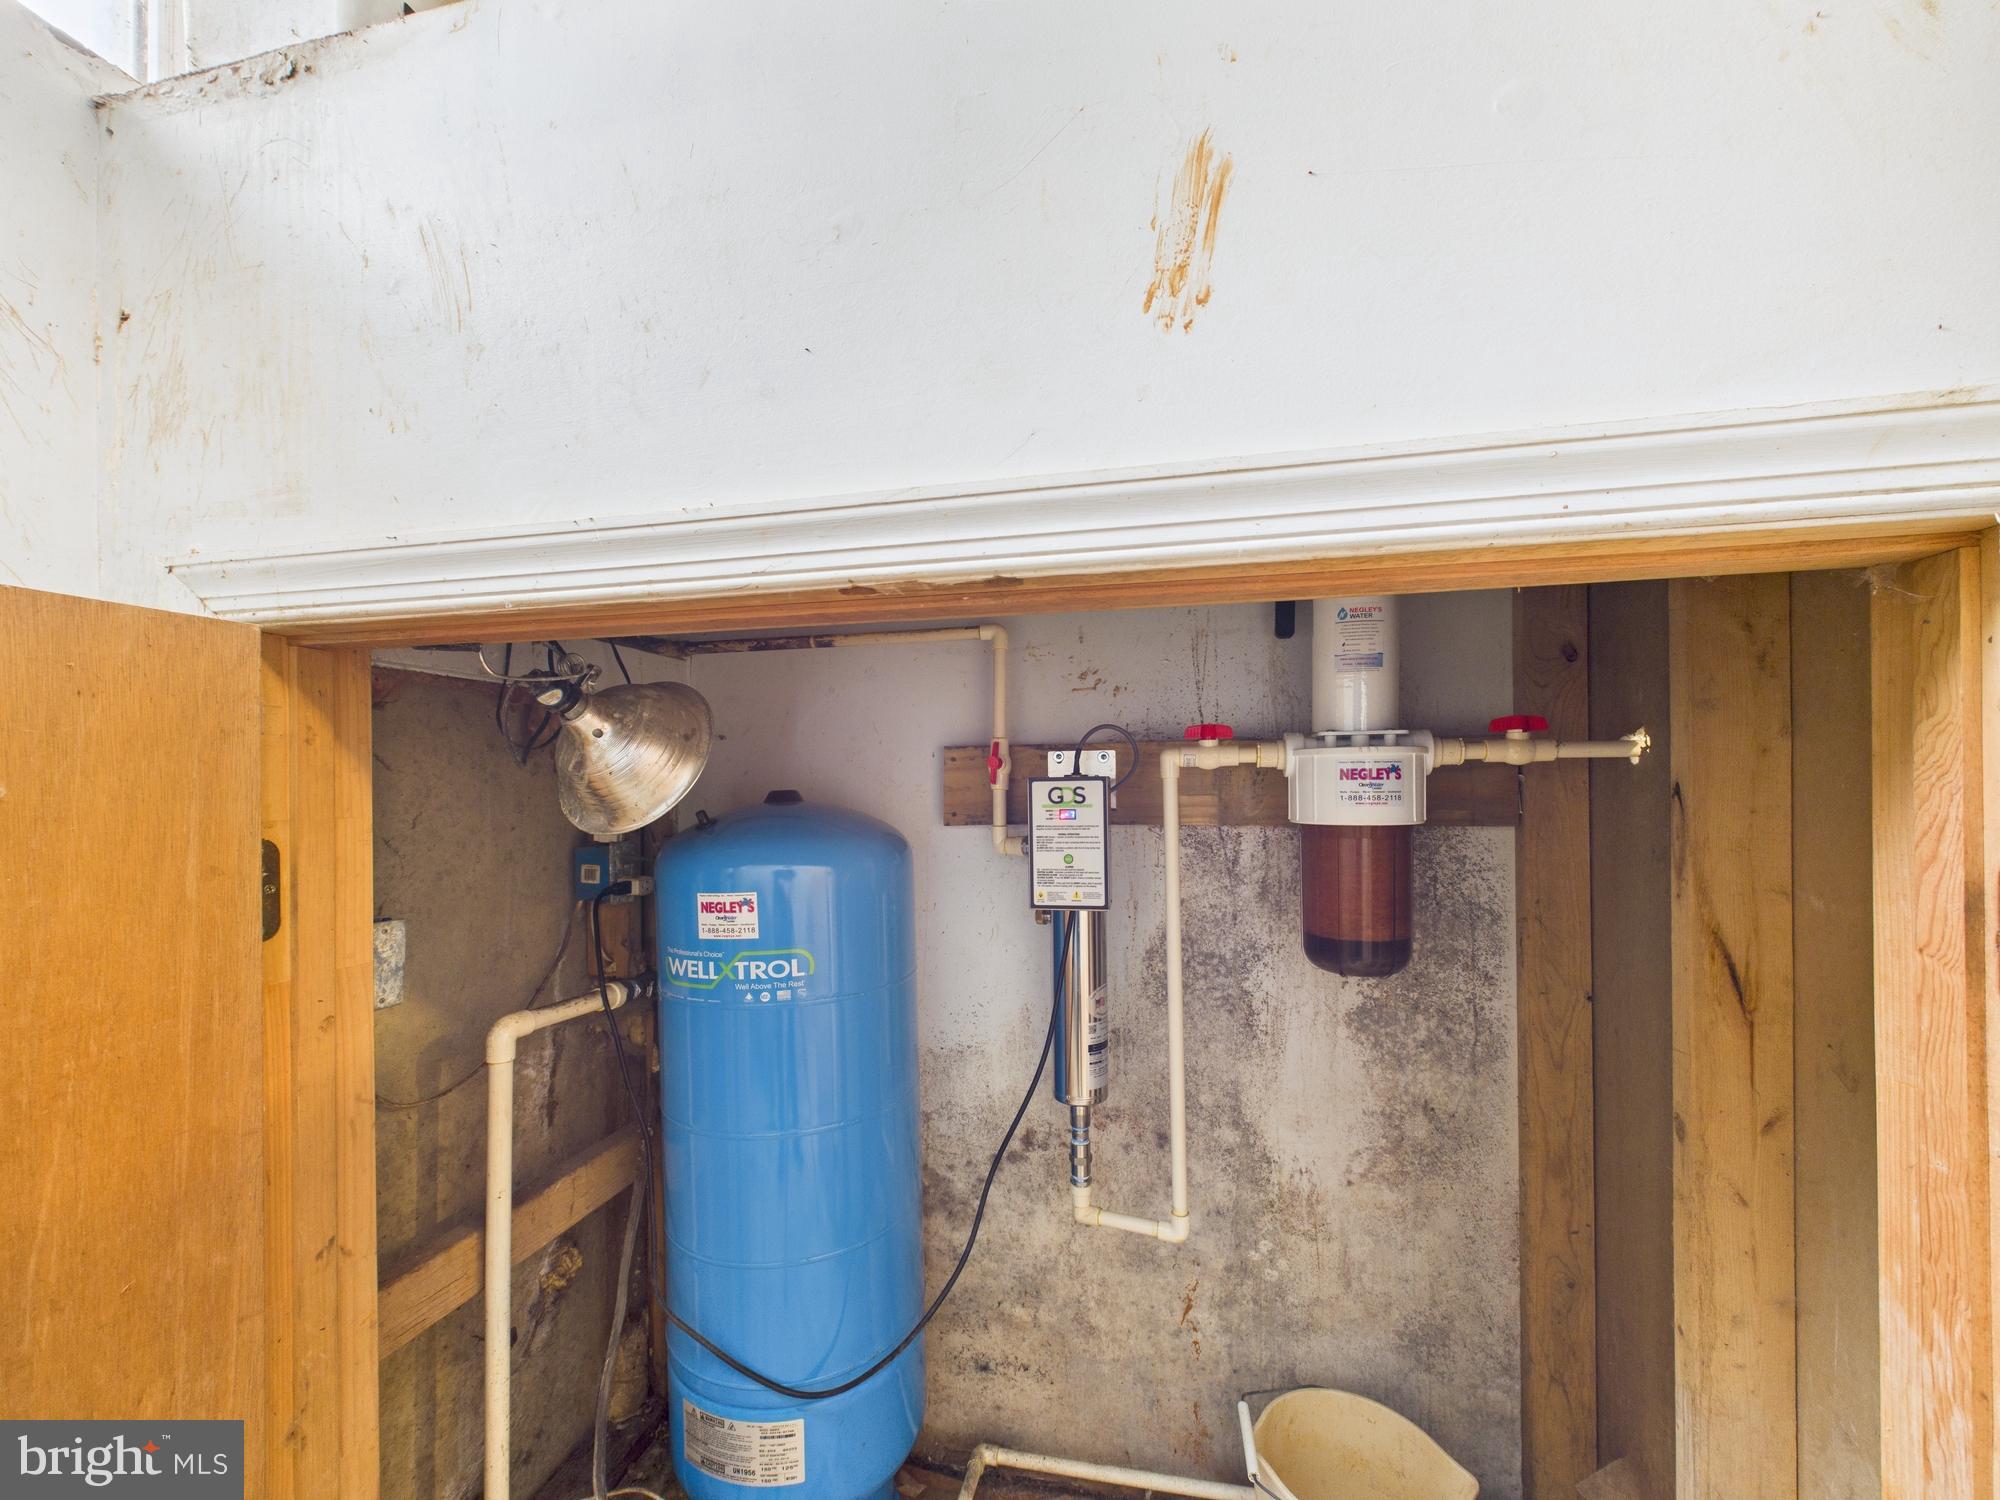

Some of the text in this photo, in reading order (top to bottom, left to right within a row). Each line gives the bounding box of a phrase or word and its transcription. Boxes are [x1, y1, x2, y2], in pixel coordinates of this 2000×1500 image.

[1339, 765, 1402, 780] NEGLEY'S
[1340, 794, 1402, 802] 1-888-458-2118
[701, 900, 755, 914] NEGLEY'S
[751, 982, 772, 990] Above
[774, 981, 787, 989] The
